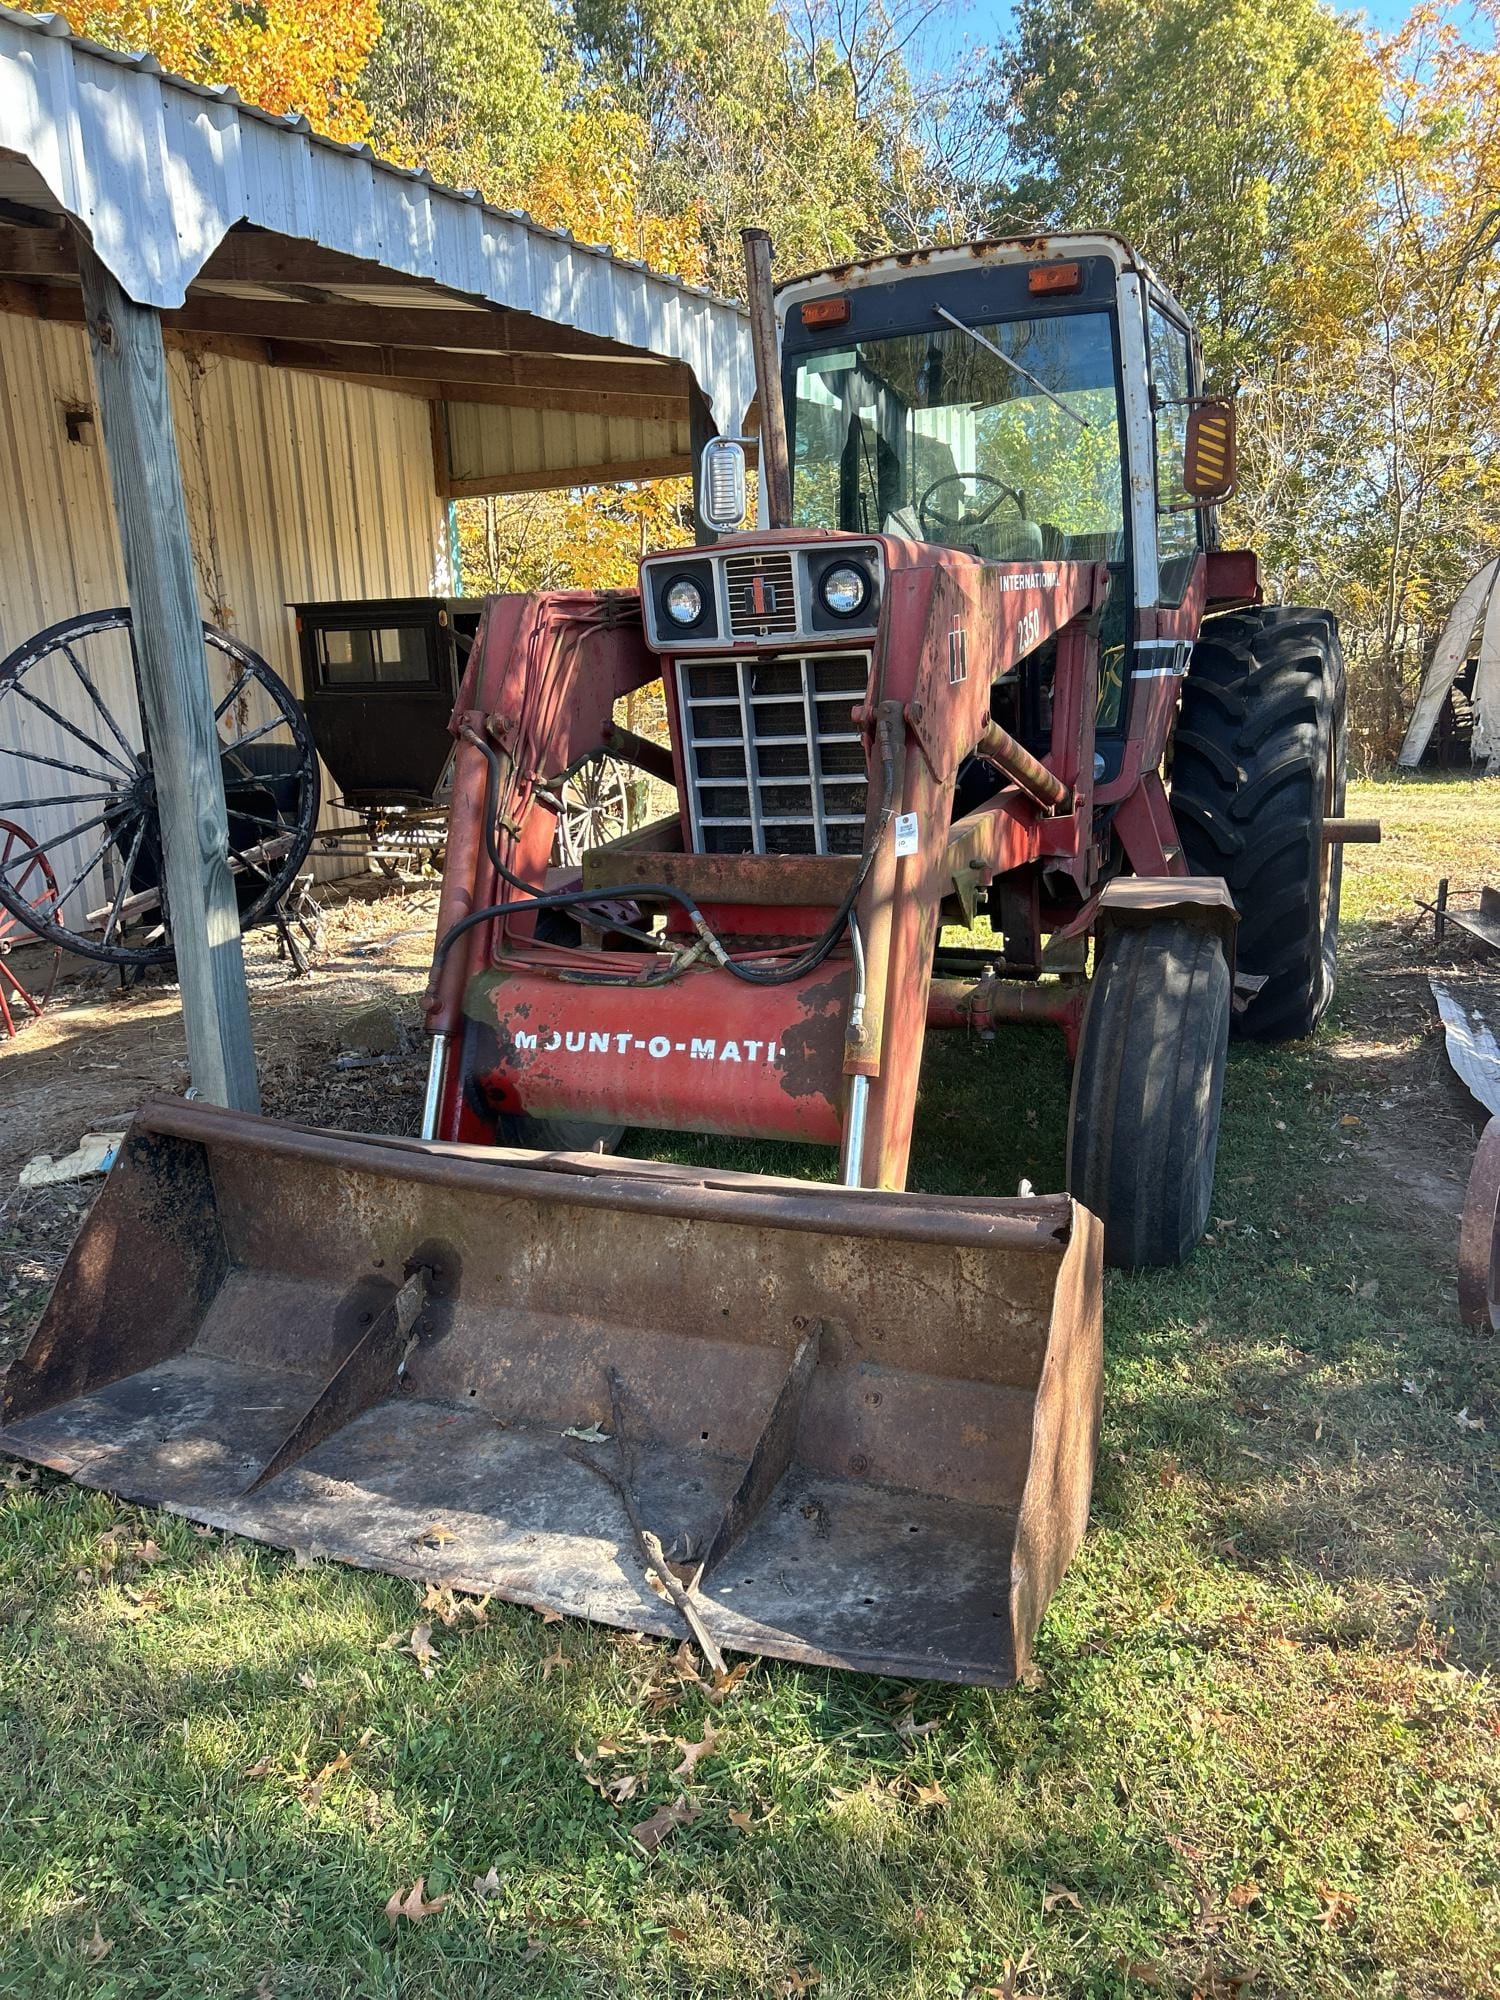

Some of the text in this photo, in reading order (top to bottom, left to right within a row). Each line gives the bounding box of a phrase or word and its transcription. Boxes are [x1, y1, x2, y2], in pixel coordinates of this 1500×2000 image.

[1000, 573, 1060, 592] INTERNATIONAL
[1017, 607, 1040, 654] 2350
[514, 1030, 786, 1062] MOUNT-O-MATI
